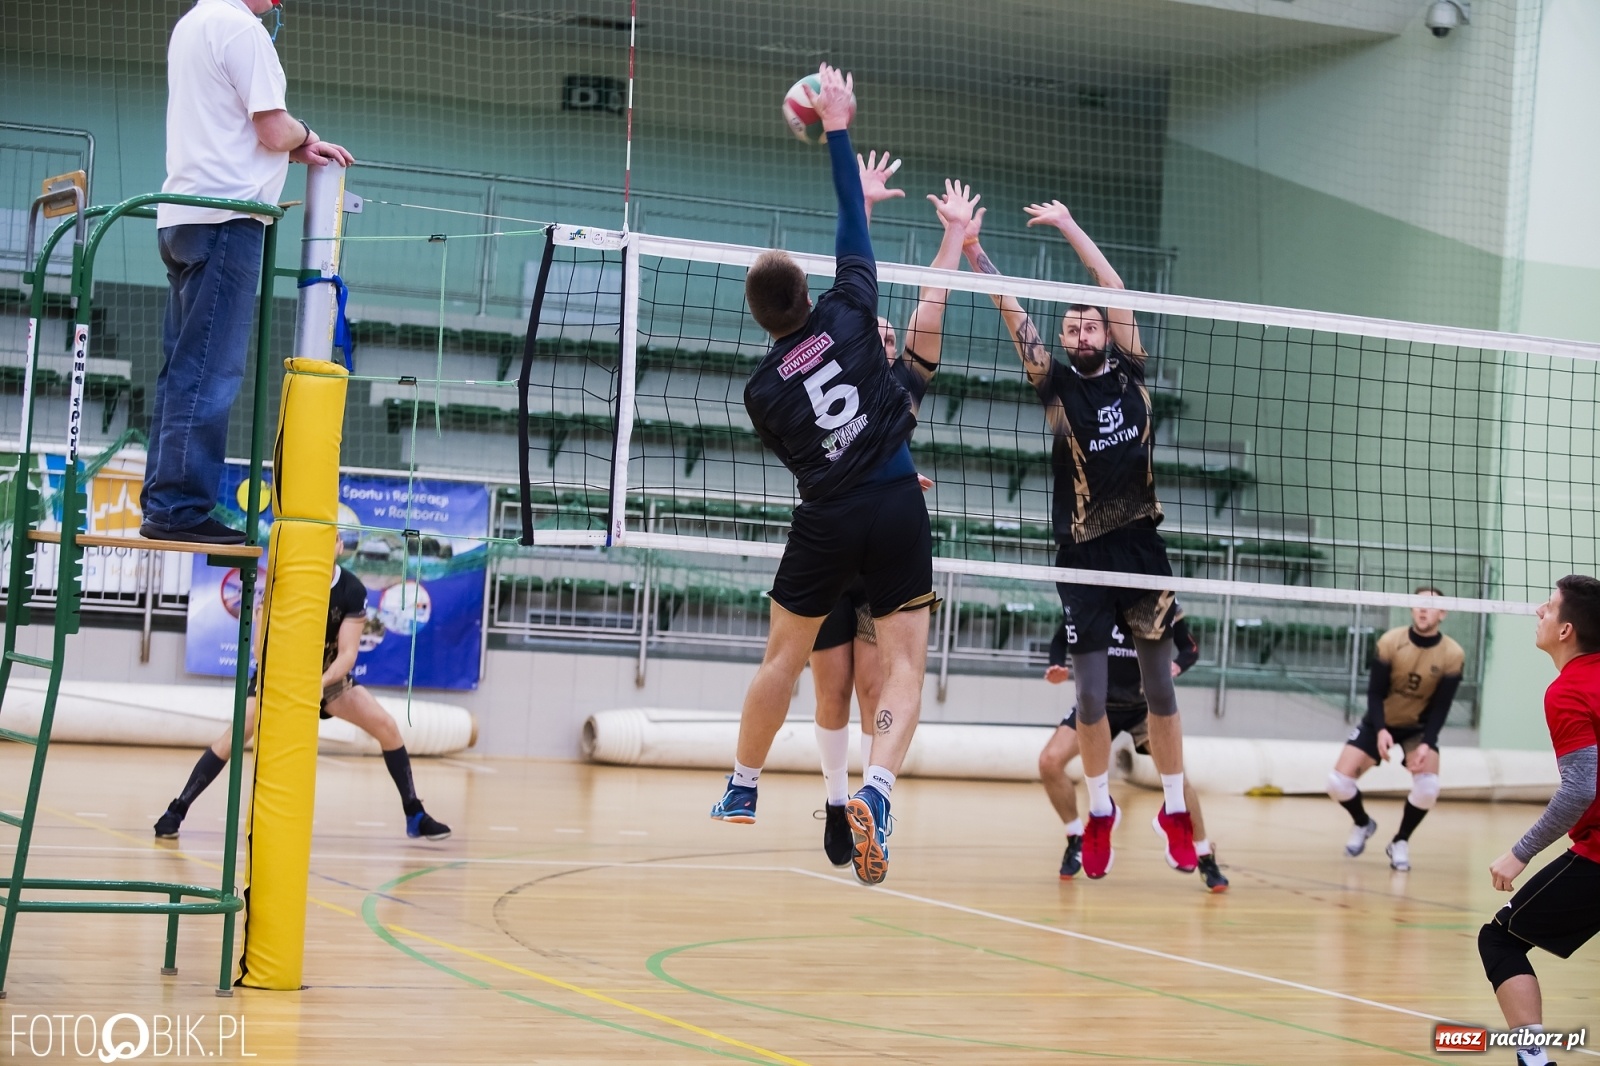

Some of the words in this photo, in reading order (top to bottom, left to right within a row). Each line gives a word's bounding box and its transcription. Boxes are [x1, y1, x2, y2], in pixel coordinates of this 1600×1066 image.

[782, 338, 829, 376] PIWIARNIA
[803, 359, 860, 430] 5
[342, 485, 384, 501] Sportu
[374, 506, 386, 517] w
[1111, 624, 1125, 645] 4
